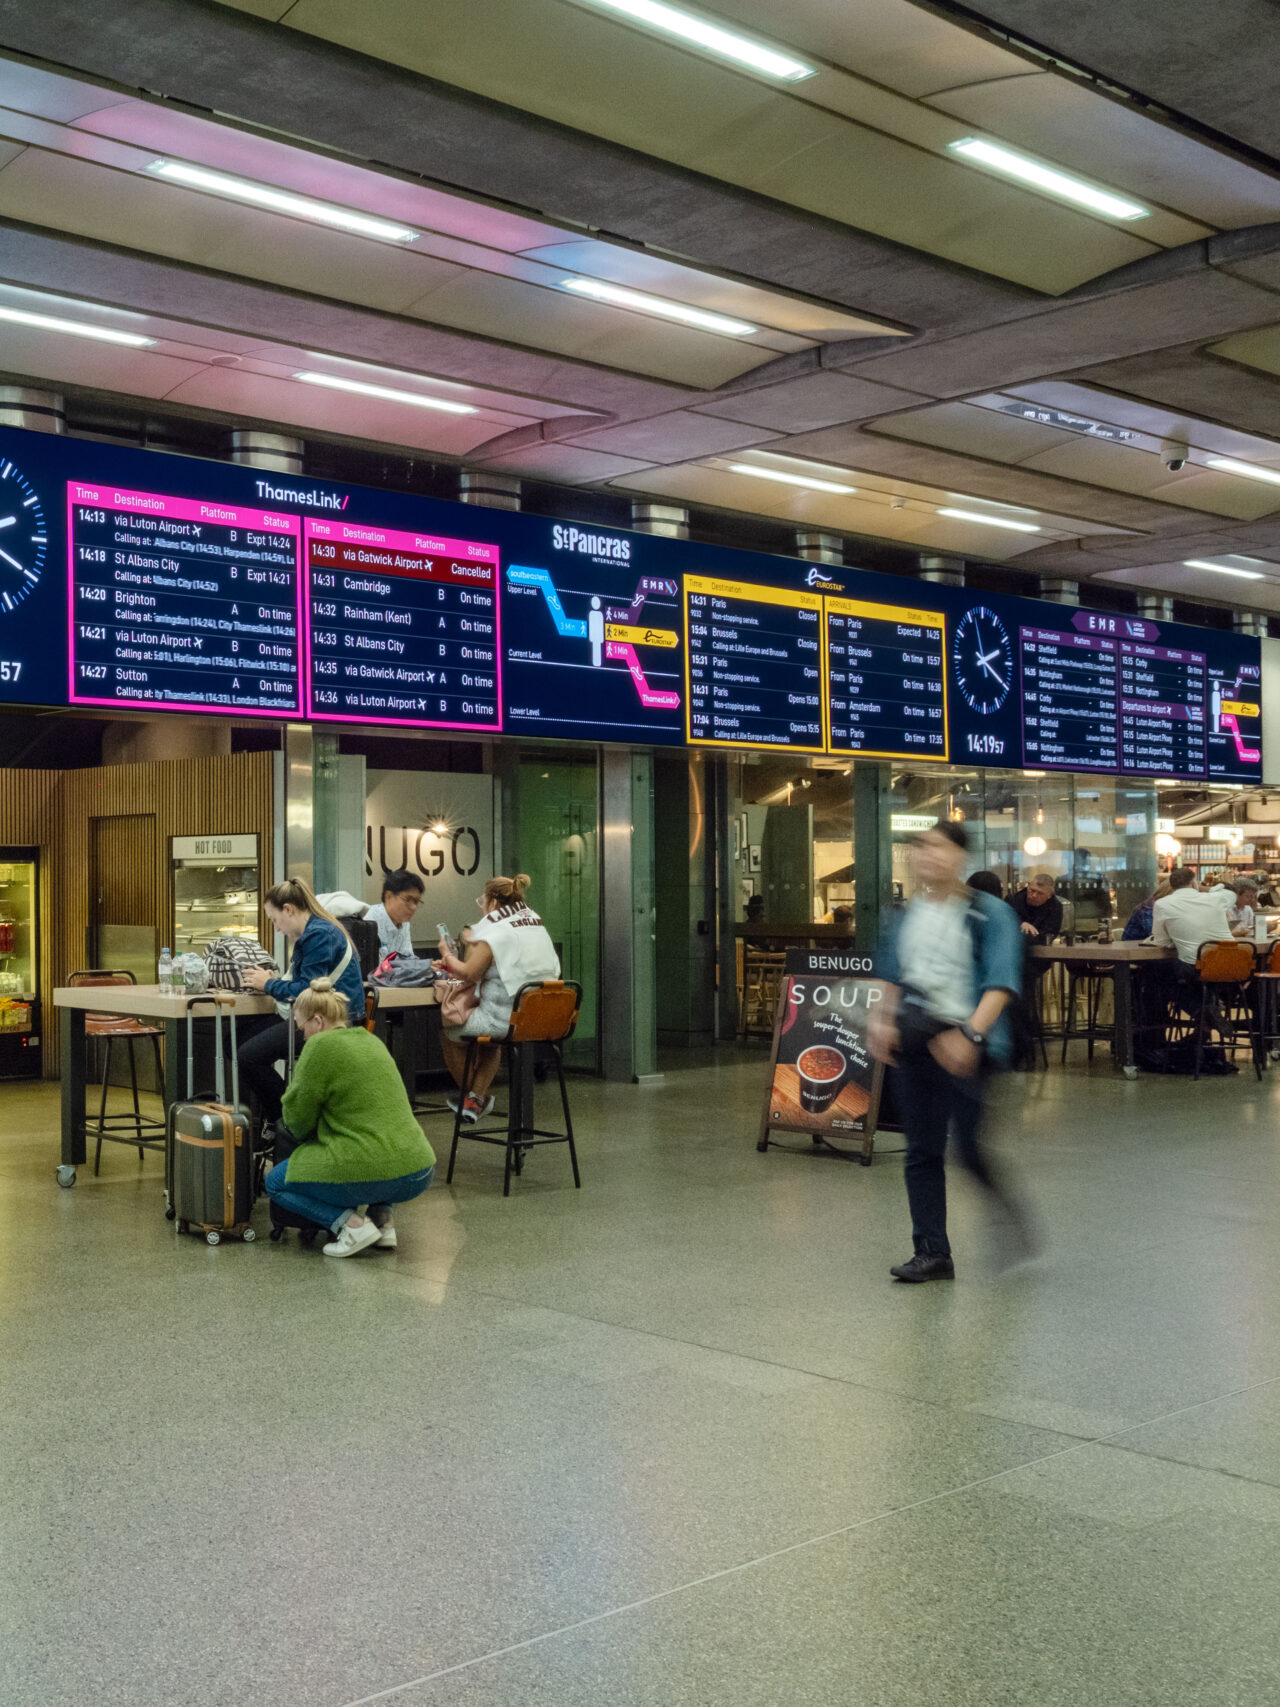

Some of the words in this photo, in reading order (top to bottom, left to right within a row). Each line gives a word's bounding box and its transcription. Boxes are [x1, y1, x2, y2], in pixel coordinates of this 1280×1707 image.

[256, 481, 342, 510] ThamesLink
[76, 488, 98, 501] Time
[114, 493, 165, 511] Destination
[201, 506, 237, 521] Platform
[263, 515, 289, 528] Status
[79, 509, 105, 525] 14:13
[114, 515, 128, 528] via
[130, 515, 155, 530] Luton
[157, 519, 190, 537] Airport
[230, 530, 237, 542] B
[247, 533, 266, 548] Expt
[269, 536, 290, 549] 14:24
[79, 547, 106, 563] 14:18
[114, 552, 125, 566] St
[127, 553, 158, 570] Albans
[160, 558, 180, 573] City
[231, 567, 238, 578] B
[247, 570, 266, 584] Expt
[269, 572, 291, 585] 14:21
[312, 544, 335, 558] 14:30
[343, 550, 356, 561] via
[358, 550, 392, 568] Gatwick
[393, 555, 422, 572] Airport
[451, 564, 491, 580] Cancelled
[592, 557, 630, 567] INTERNATIONAL
[510, 570, 549, 582] southeastern
[313, 574, 335, 587] 14:31
[344, 578, 391, 595] Cambridge
[438, 589, 445, 600] B
[461, 591, 472, 603] On
[474, 593, 491, 606] time
[79, 587, 106, 602] 14:20
[115, 590, 156, 608] Brighton
[231, 603, 238, 616] A
[258, 608, 271, 619] On
[274, 608, 292, 621] time
[691, 595, 706, 605] 14:31
[712, 598, 727, 608] Paris
[798, 611, 817, 621] Closed
[691, 625, 707, 635] 15:04
[712, 628, 738, 639] Brussels
[798, 639, 817, 650] Closing
[829, 616, 844, 626] From
[847, 619, 862, 629] Paris
[897, 626, 921, 638] Expected
[927, 629, 940, 639] 14:25
[509, 649, 527, 658] Current
[529, 651, 542, 659] Level
[830, 644, 845, 654] From
[848, 647, 872, 658] Brussels
[903, 653, 911, 662] On
[912, 655, 923, 664] time
[927, 656, 940, 665] 15:57
[0, 660, 22, 681] 57
[1122, 701, 1145, 710] Departures
[1152, 704, 1166, 713] airport
[967, 734, 994, 753] 14:19
[994, 742, 1004, 754] 57
[195, 841, 210, 854] HOT
[212, 840, 232, 853] FOOD
[809, 956, 872, 971] BENUGO
[790, 984, 883, 1009] SOUP
[830, 1012, 843, 1023] The
[814, 1021, 859, 1039] souper-douper
[836, 1035, 866, 1055] lunchtime
[850, 1053, 868, 1068] choice
